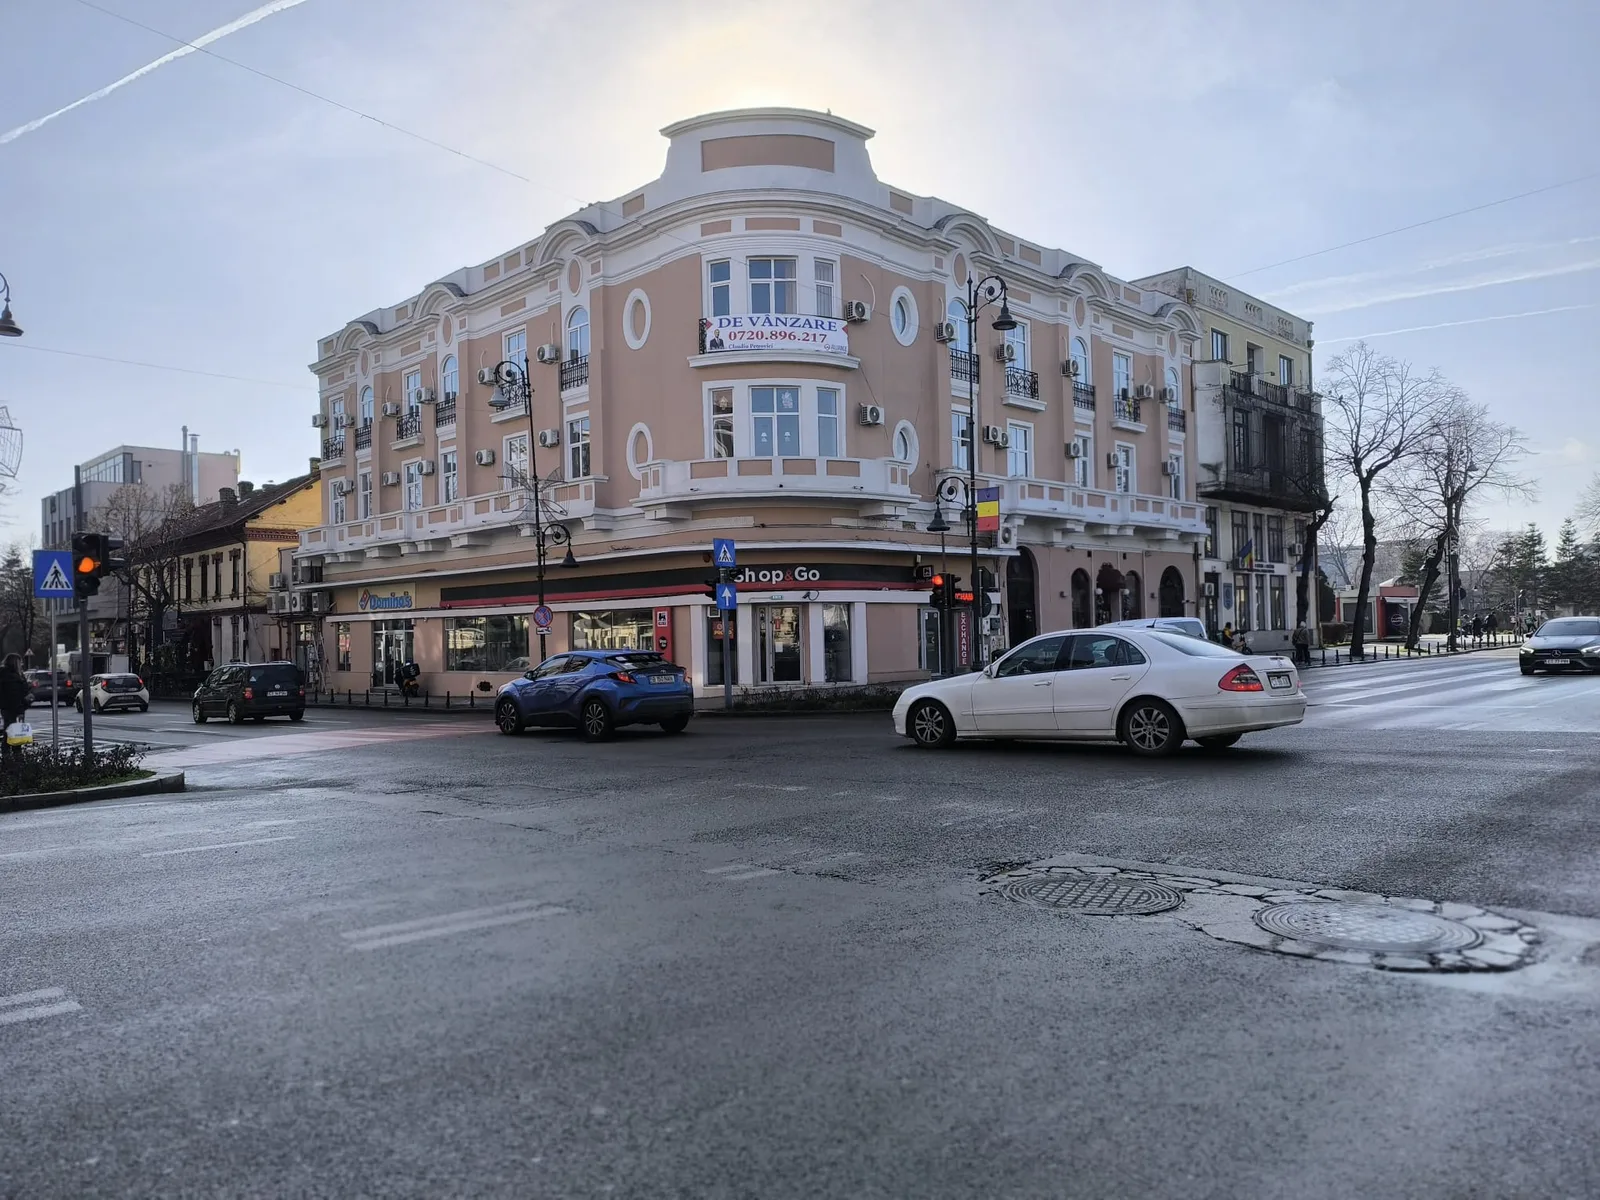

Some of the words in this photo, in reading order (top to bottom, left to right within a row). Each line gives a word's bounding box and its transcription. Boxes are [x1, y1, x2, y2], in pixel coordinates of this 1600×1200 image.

[718, 316, 743, 329] DE
[747, 313, 838, 332] VÂNZARE
[728, 330, 828, 343] 0720.896.217
